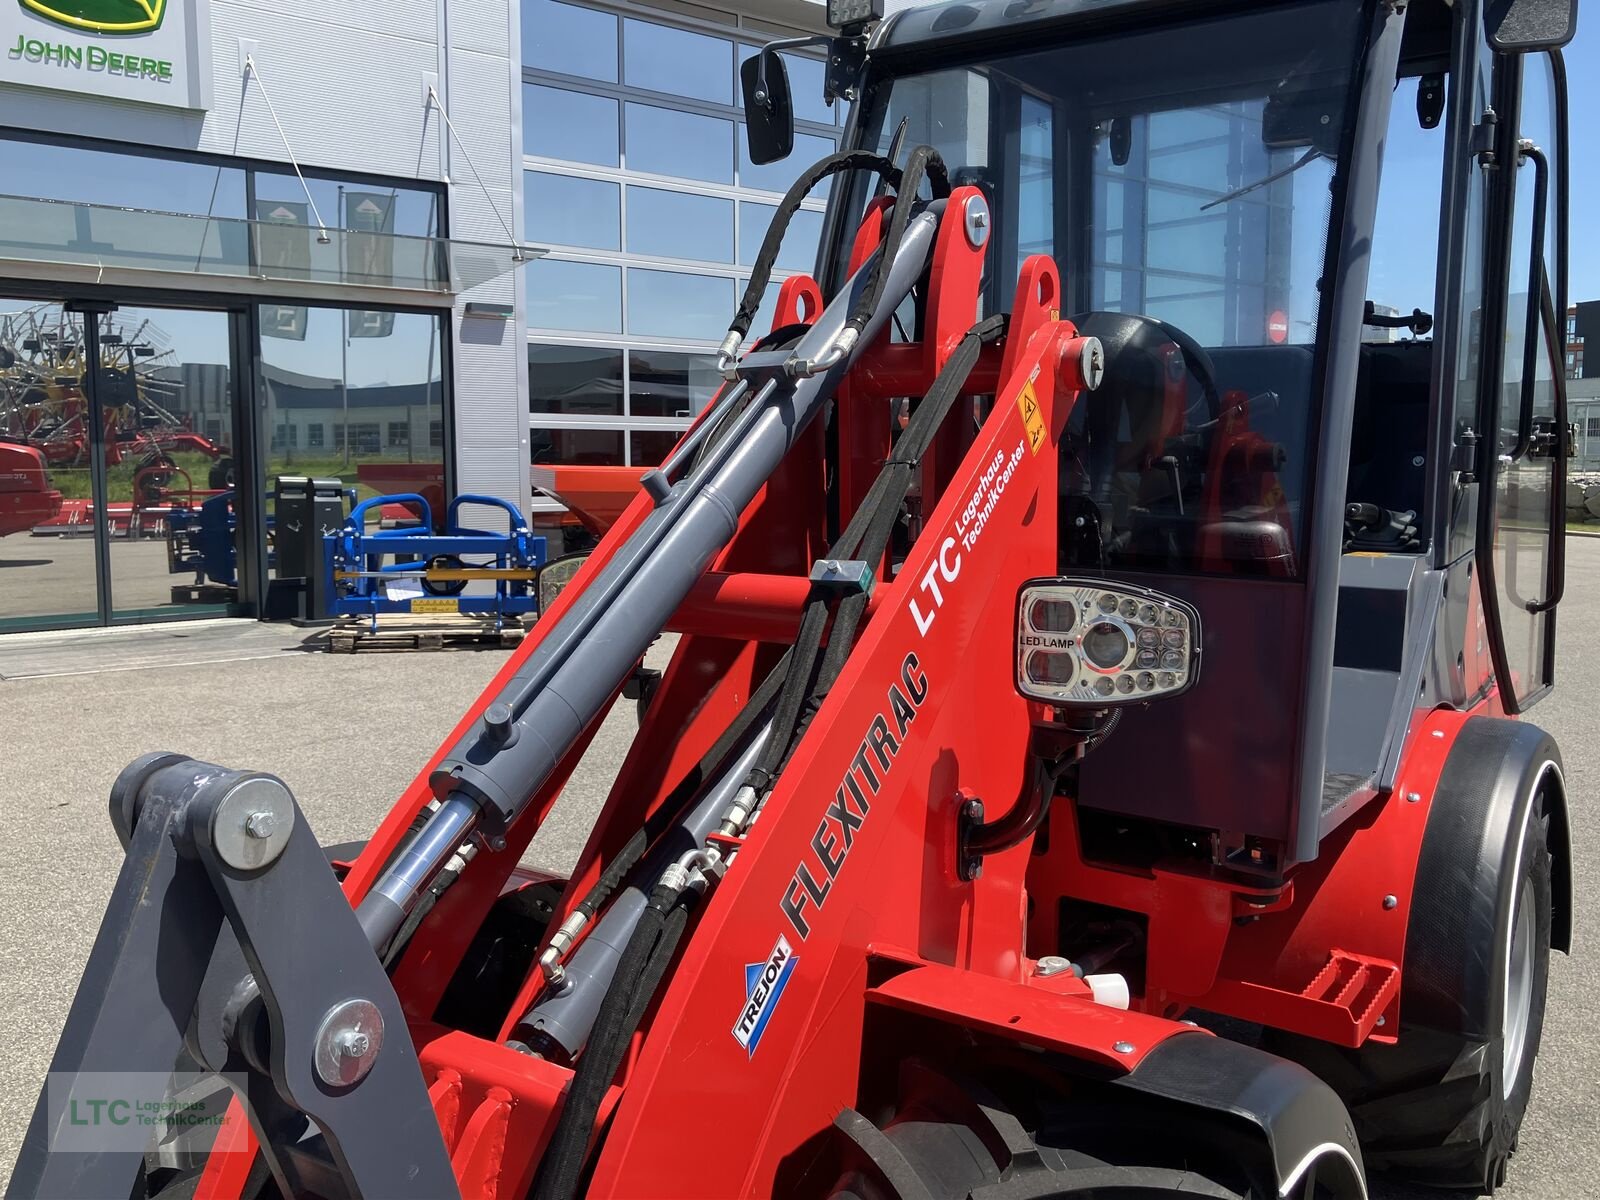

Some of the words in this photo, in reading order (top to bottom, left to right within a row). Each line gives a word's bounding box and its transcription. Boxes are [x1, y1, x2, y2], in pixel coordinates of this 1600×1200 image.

[9, 34, 82, 65] JOHN
[86, 45, 173, 77] DEERE
[954, 448, 1005, 537] Lagerhaus
[961, 439, 1026, 553] TechnikCenter
[908, 536, 962, 638] LTC
[1020, 635, 1041, 646] LED
[1043, 638, 1075, 649] LAMP
[779, 650, 929, 942] FLEXITRAC
[738, 946, 787, 1036] TREJON
